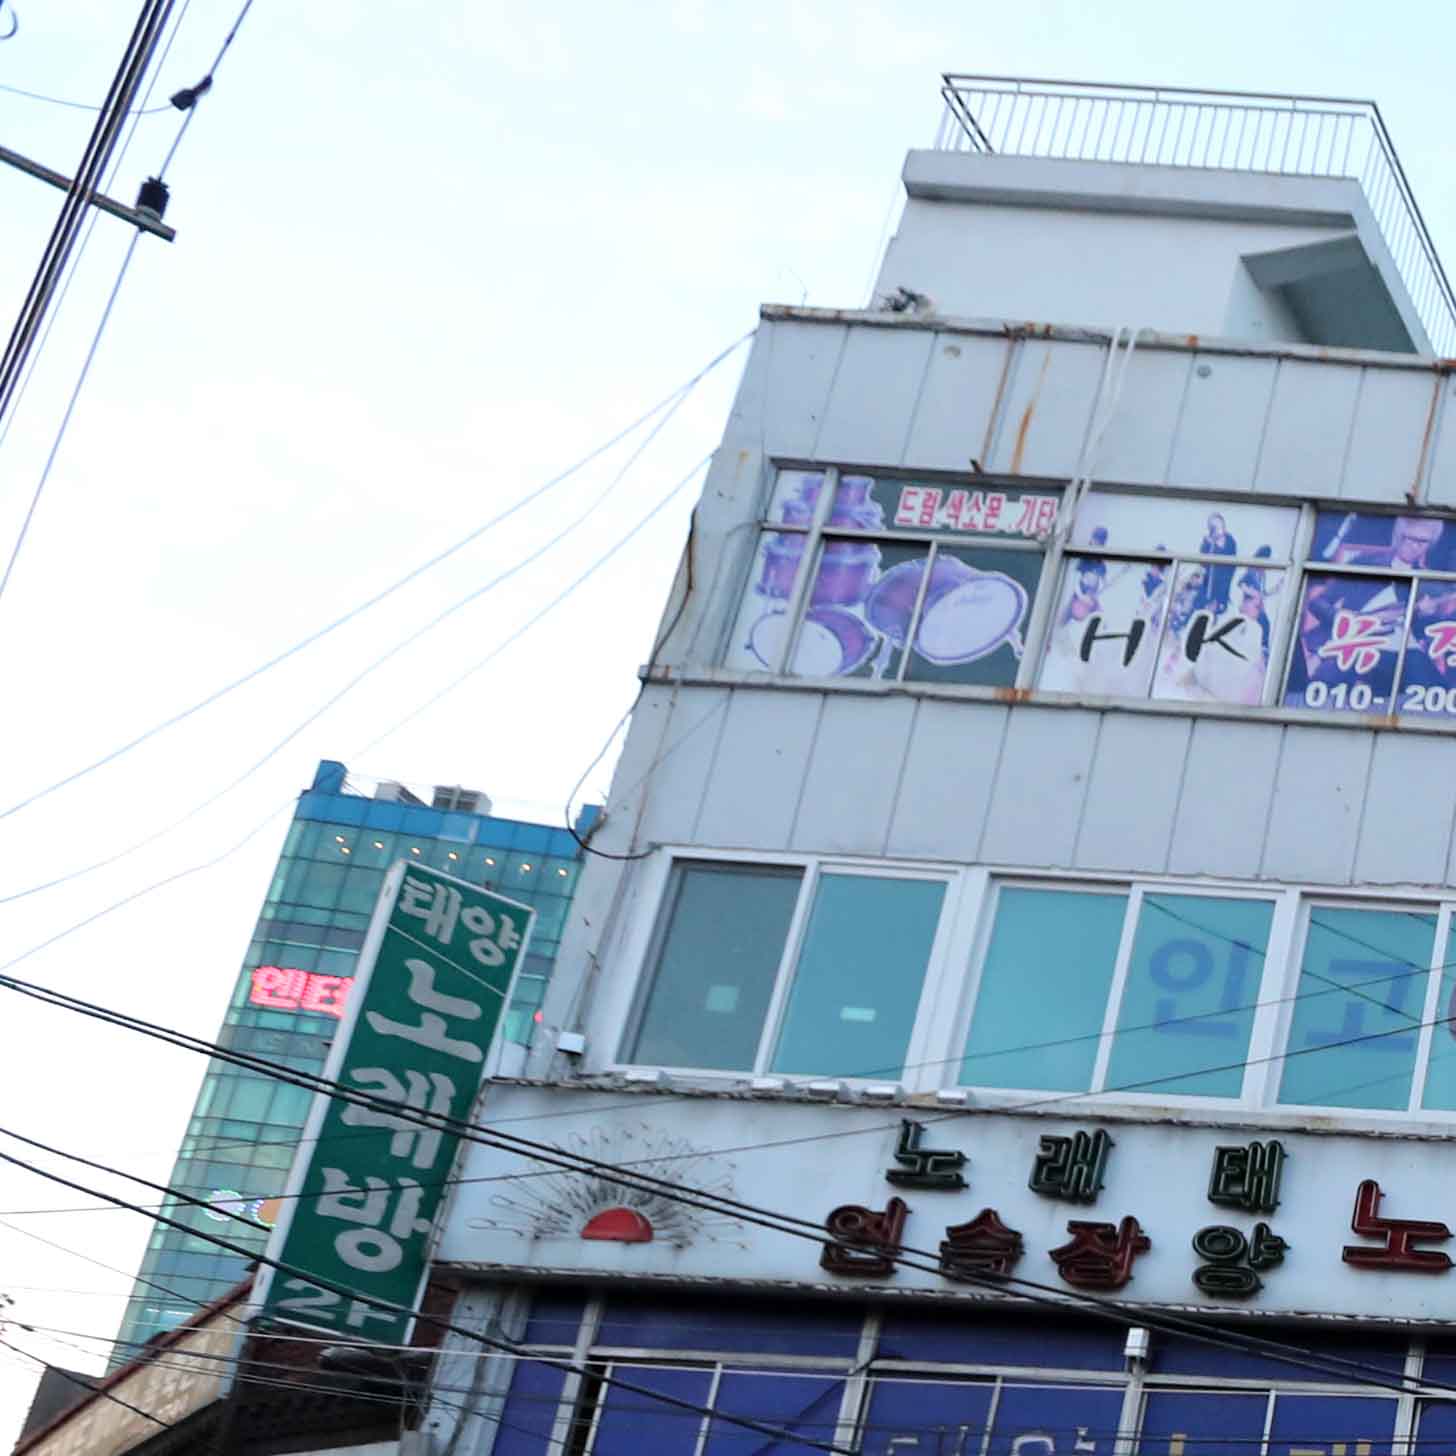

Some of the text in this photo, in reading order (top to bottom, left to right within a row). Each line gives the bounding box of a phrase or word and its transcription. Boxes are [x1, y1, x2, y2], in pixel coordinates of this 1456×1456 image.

[894, 488, 941, 526] 드럼
[398, 875, 521, 967] 태양
[886, 1117, 1114, 1203] 노래
[820, 1197, 1150, 1292] 연습장
[1192, 1139, 1290, 1298] 태양
